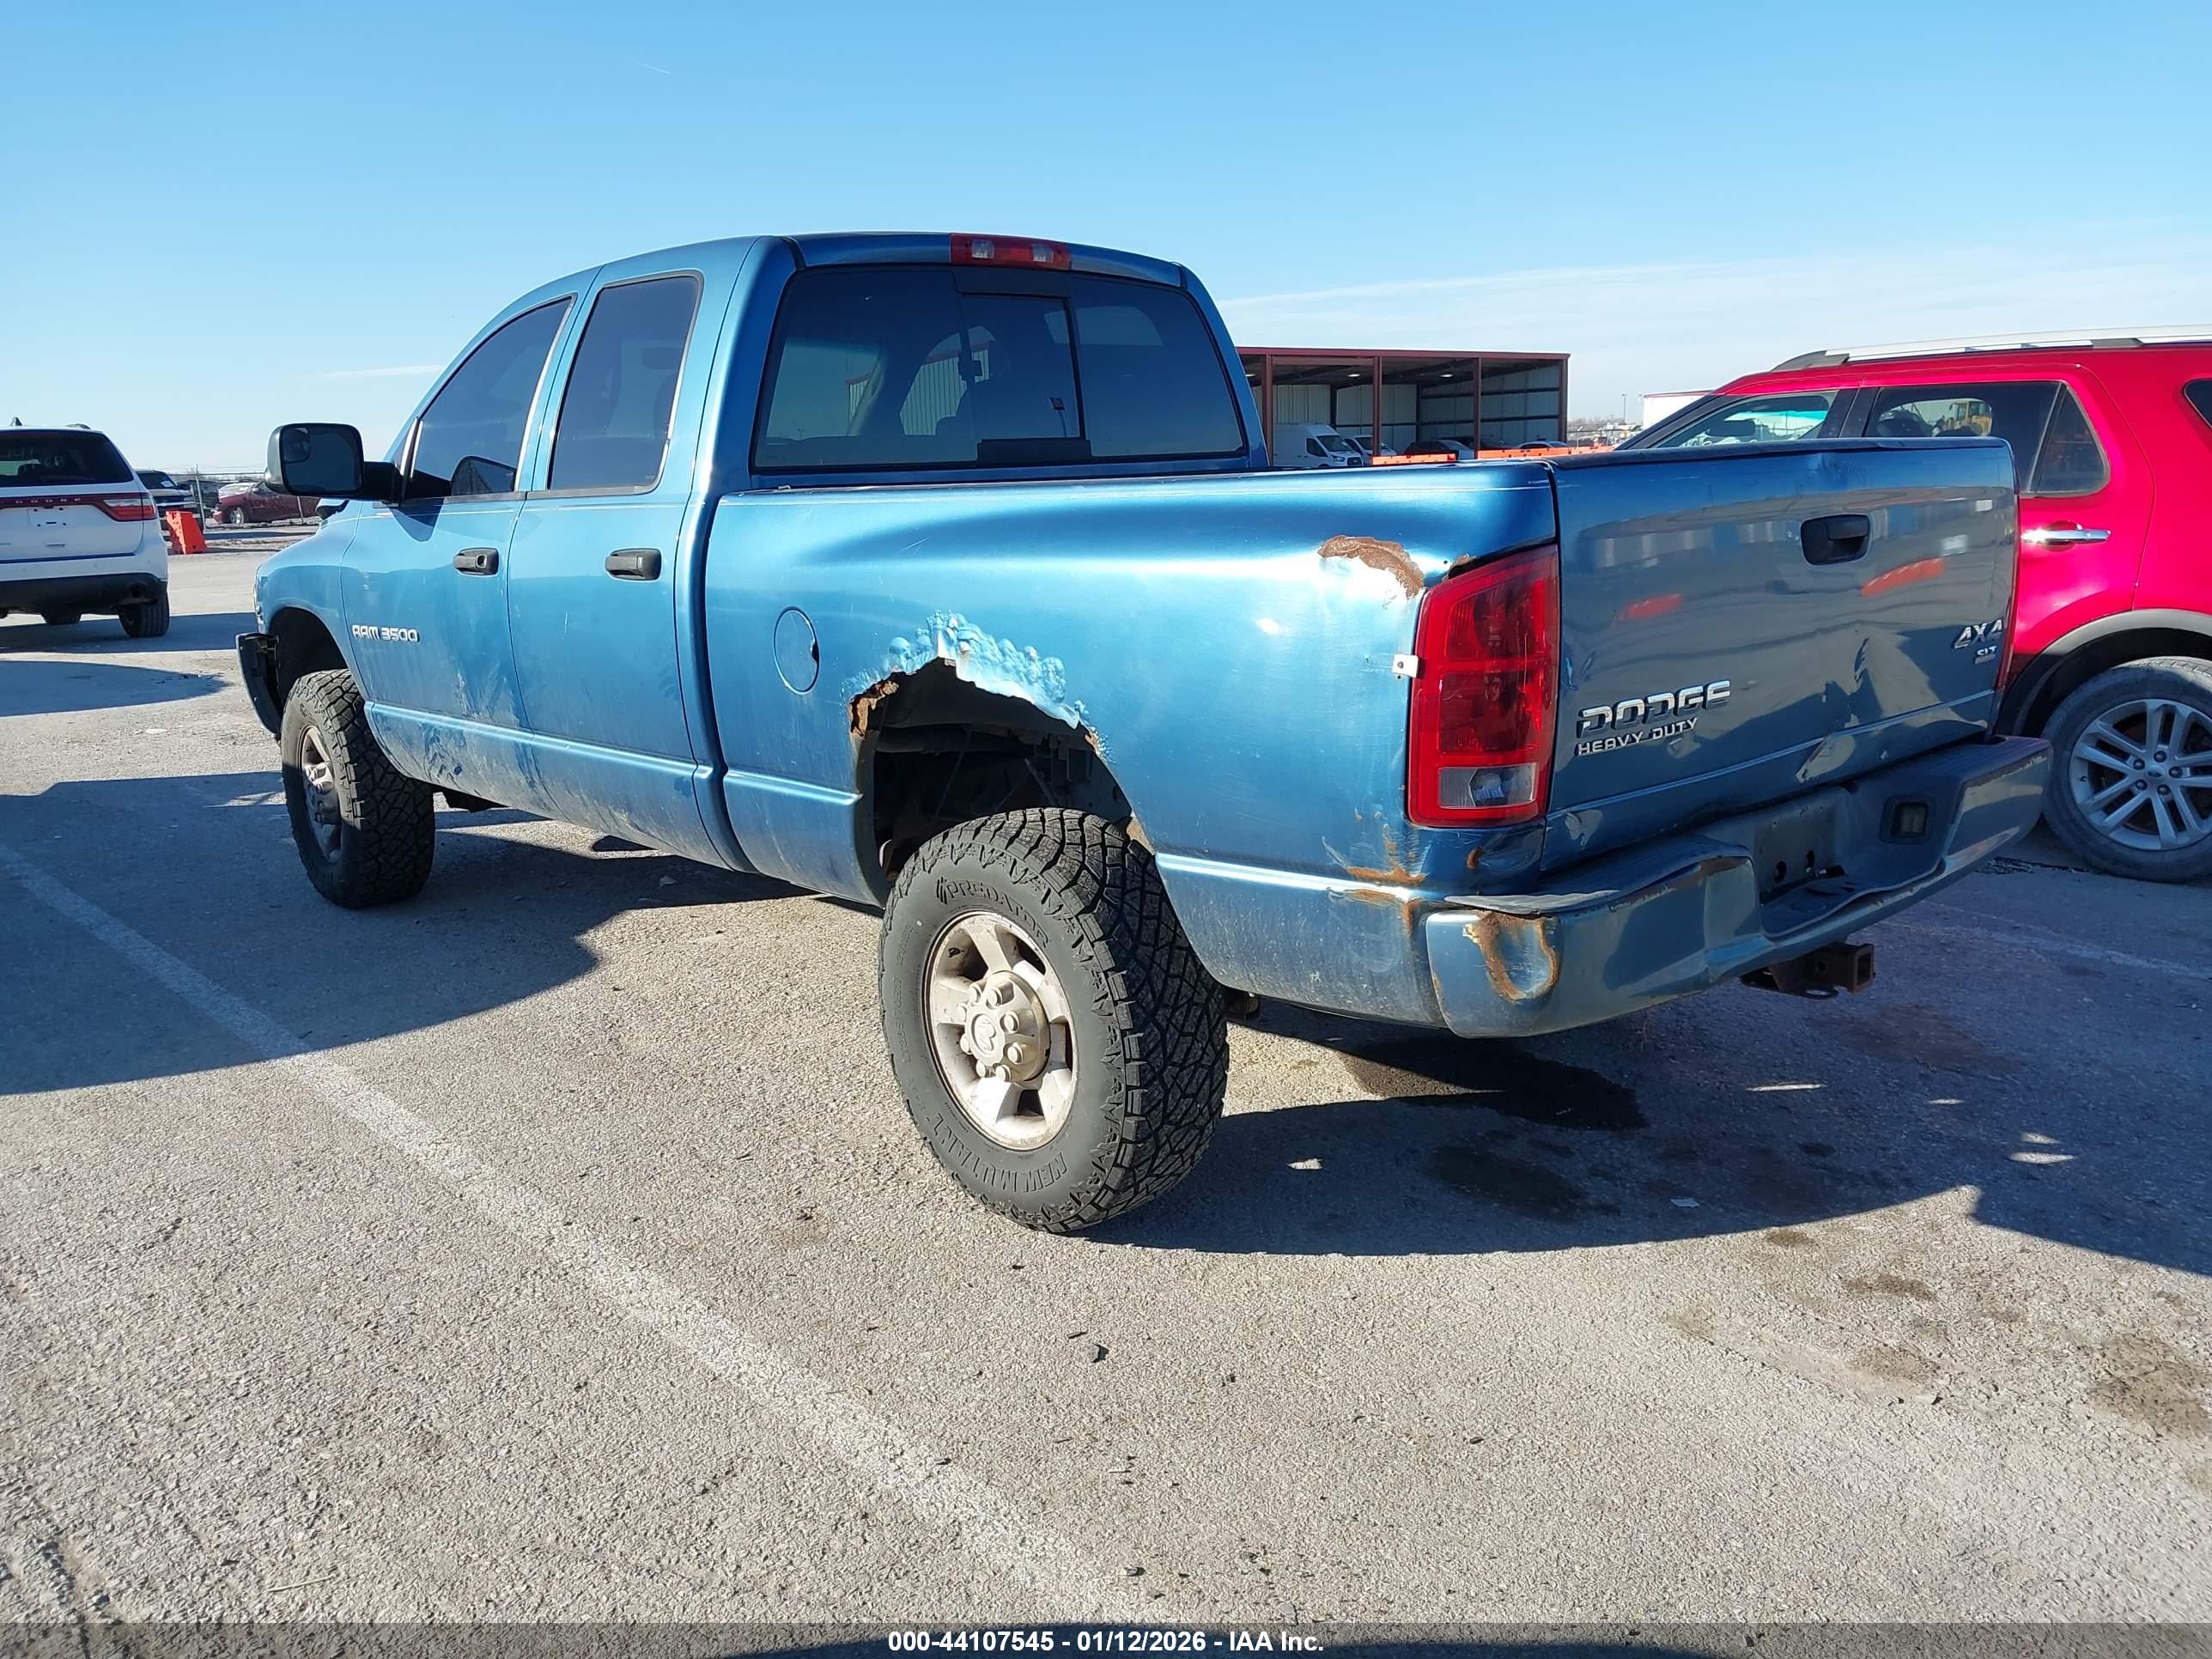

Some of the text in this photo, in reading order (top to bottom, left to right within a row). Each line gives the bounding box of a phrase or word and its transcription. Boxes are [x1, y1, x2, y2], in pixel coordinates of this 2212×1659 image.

[352, 624, 419, 643] RAM 3500
[1577, 679, 1730, 738] DODGE
[1577, 717, 1698, 756] HEAVY DUTY
[945, 878, 1050, 949] PREDATOR
